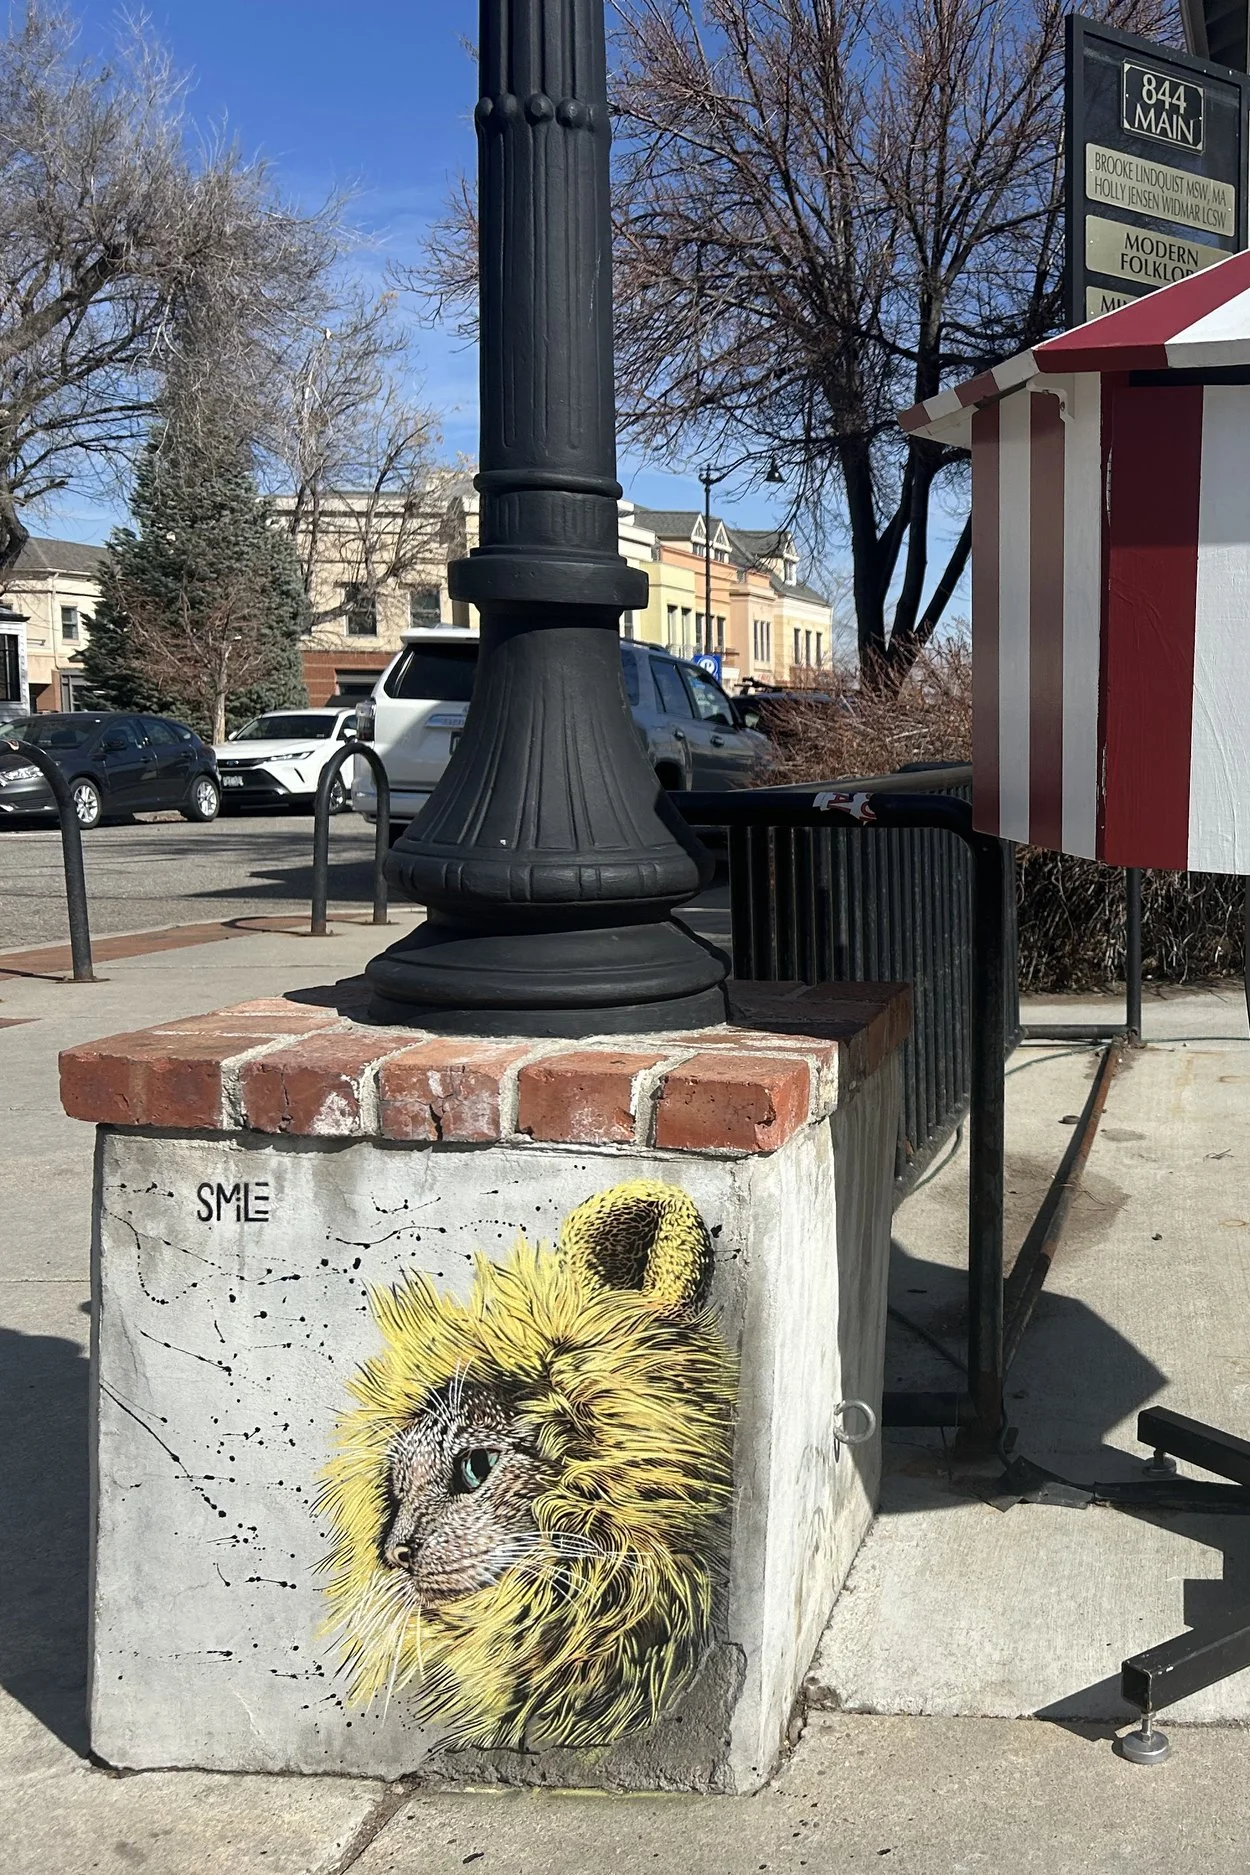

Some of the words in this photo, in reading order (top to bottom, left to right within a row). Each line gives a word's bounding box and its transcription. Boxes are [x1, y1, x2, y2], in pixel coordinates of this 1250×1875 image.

[1142, 74, 1187, 114] 844
[1134, 103, 1194, 144] MAIN
[1094, 152, 1133, 180] BROOKE
[1135, 163, 1185, 194] LINDQUIST
[1212, 187, 1227, 206] MA
[1094, 176, 1126, 201] HOLLY
[1127, 186, 1160, 210] JENSEN
[1161, 195, 1201, 222] WIDMAR
[1202, 203, 1227, 229] LCSW
[1124, 232, 1199, 267] MODERN
